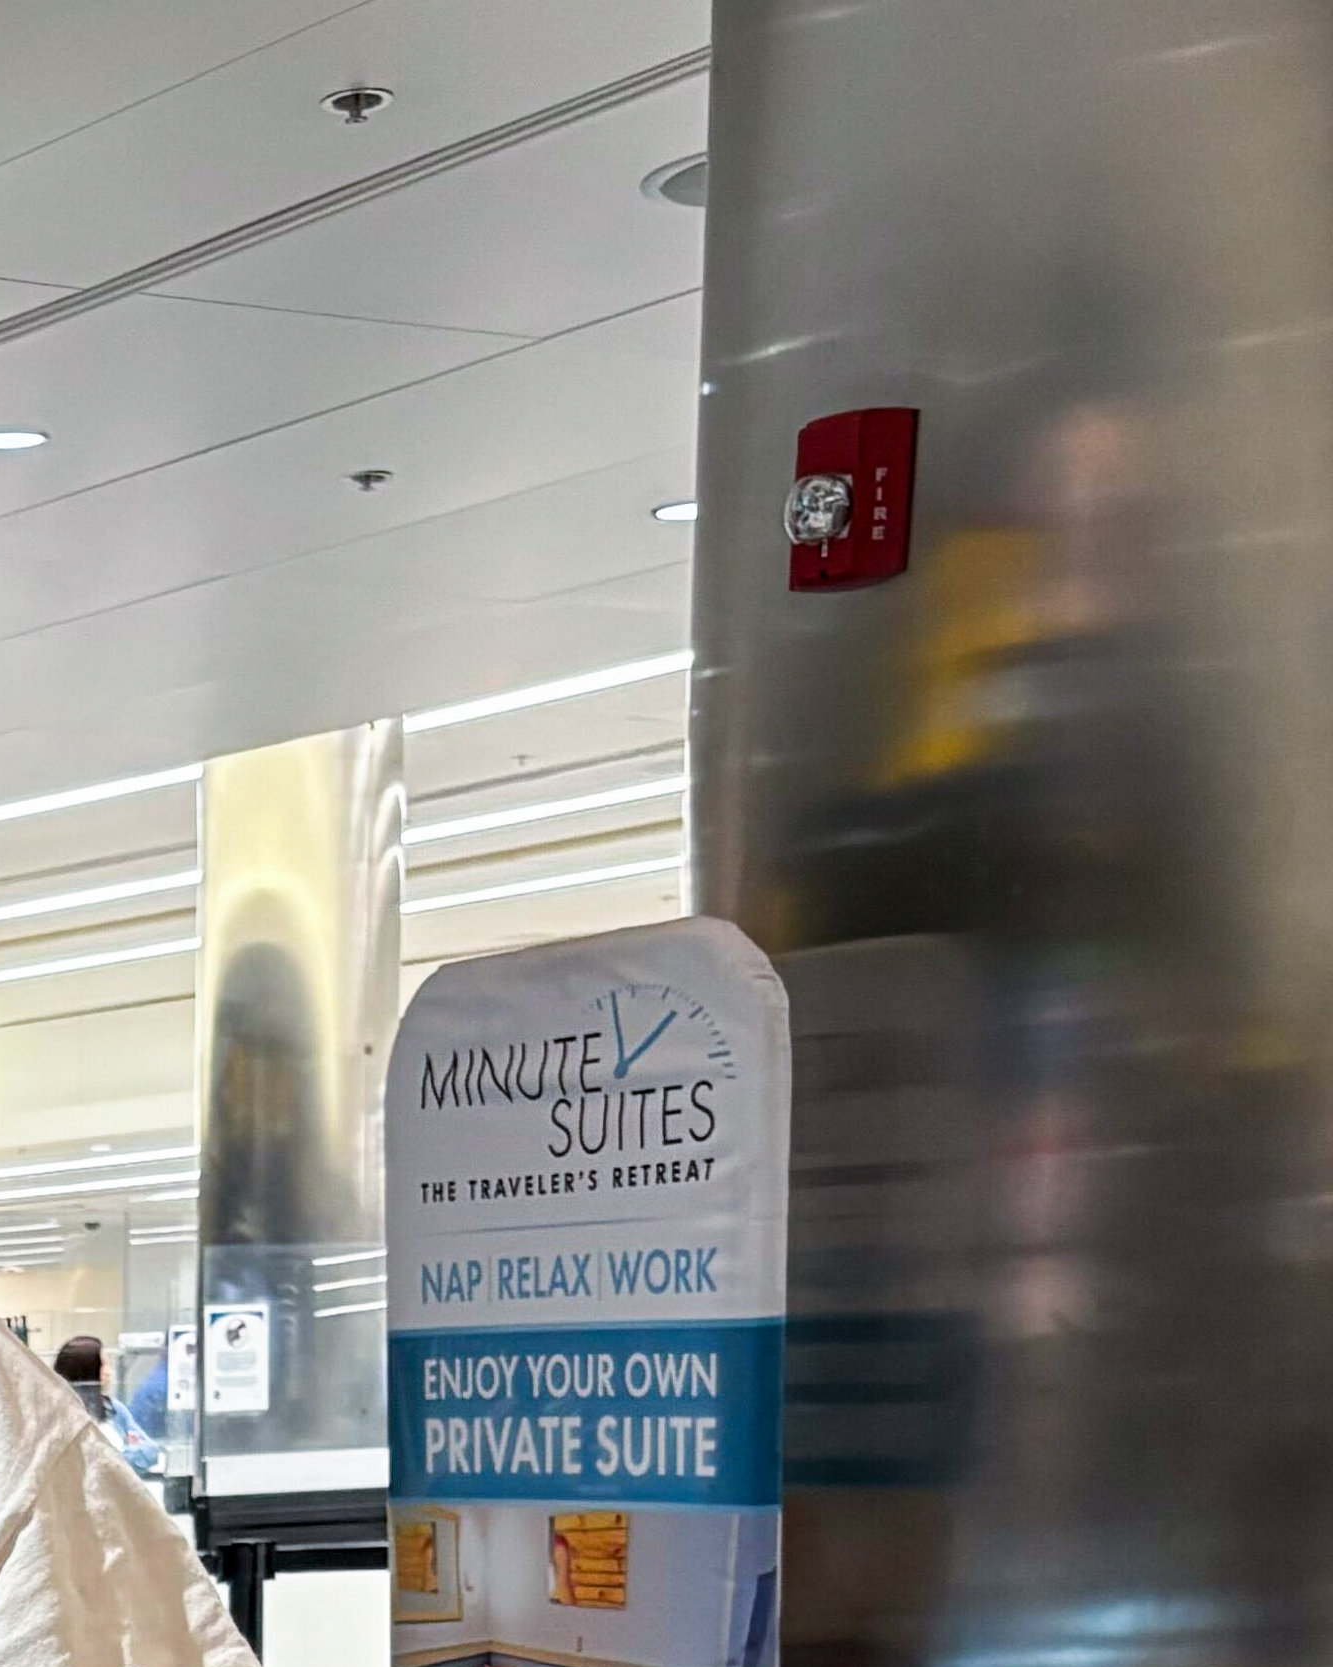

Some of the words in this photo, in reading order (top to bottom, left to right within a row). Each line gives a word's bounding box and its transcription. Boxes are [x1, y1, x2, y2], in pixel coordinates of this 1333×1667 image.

[872, 467, 888, 540] FIRE
[421, 1032, 602, 1110] MINUTE
[548, 1080, 715, 1157] SUITES
[421, 1182, 457, 1203] THE
[468, 1169, 598, 1201] TRAVELER'S
[612, 1158, 716, 1188] RETREAT
[421, 1260, 482, 1304] NAP
[497, 1253, 592, 1300] RELAX
[607, 1247, 718, 1295] WORK
[424, 1355, 518, 1400] ENJOY
[526, 1353, 615, 1398] YOUR
[624, 1352, 717, 1398] OWN
[424, 1415, 582, 1475] PRIVATE
[595, 1415, 718, 1477] SUITE
